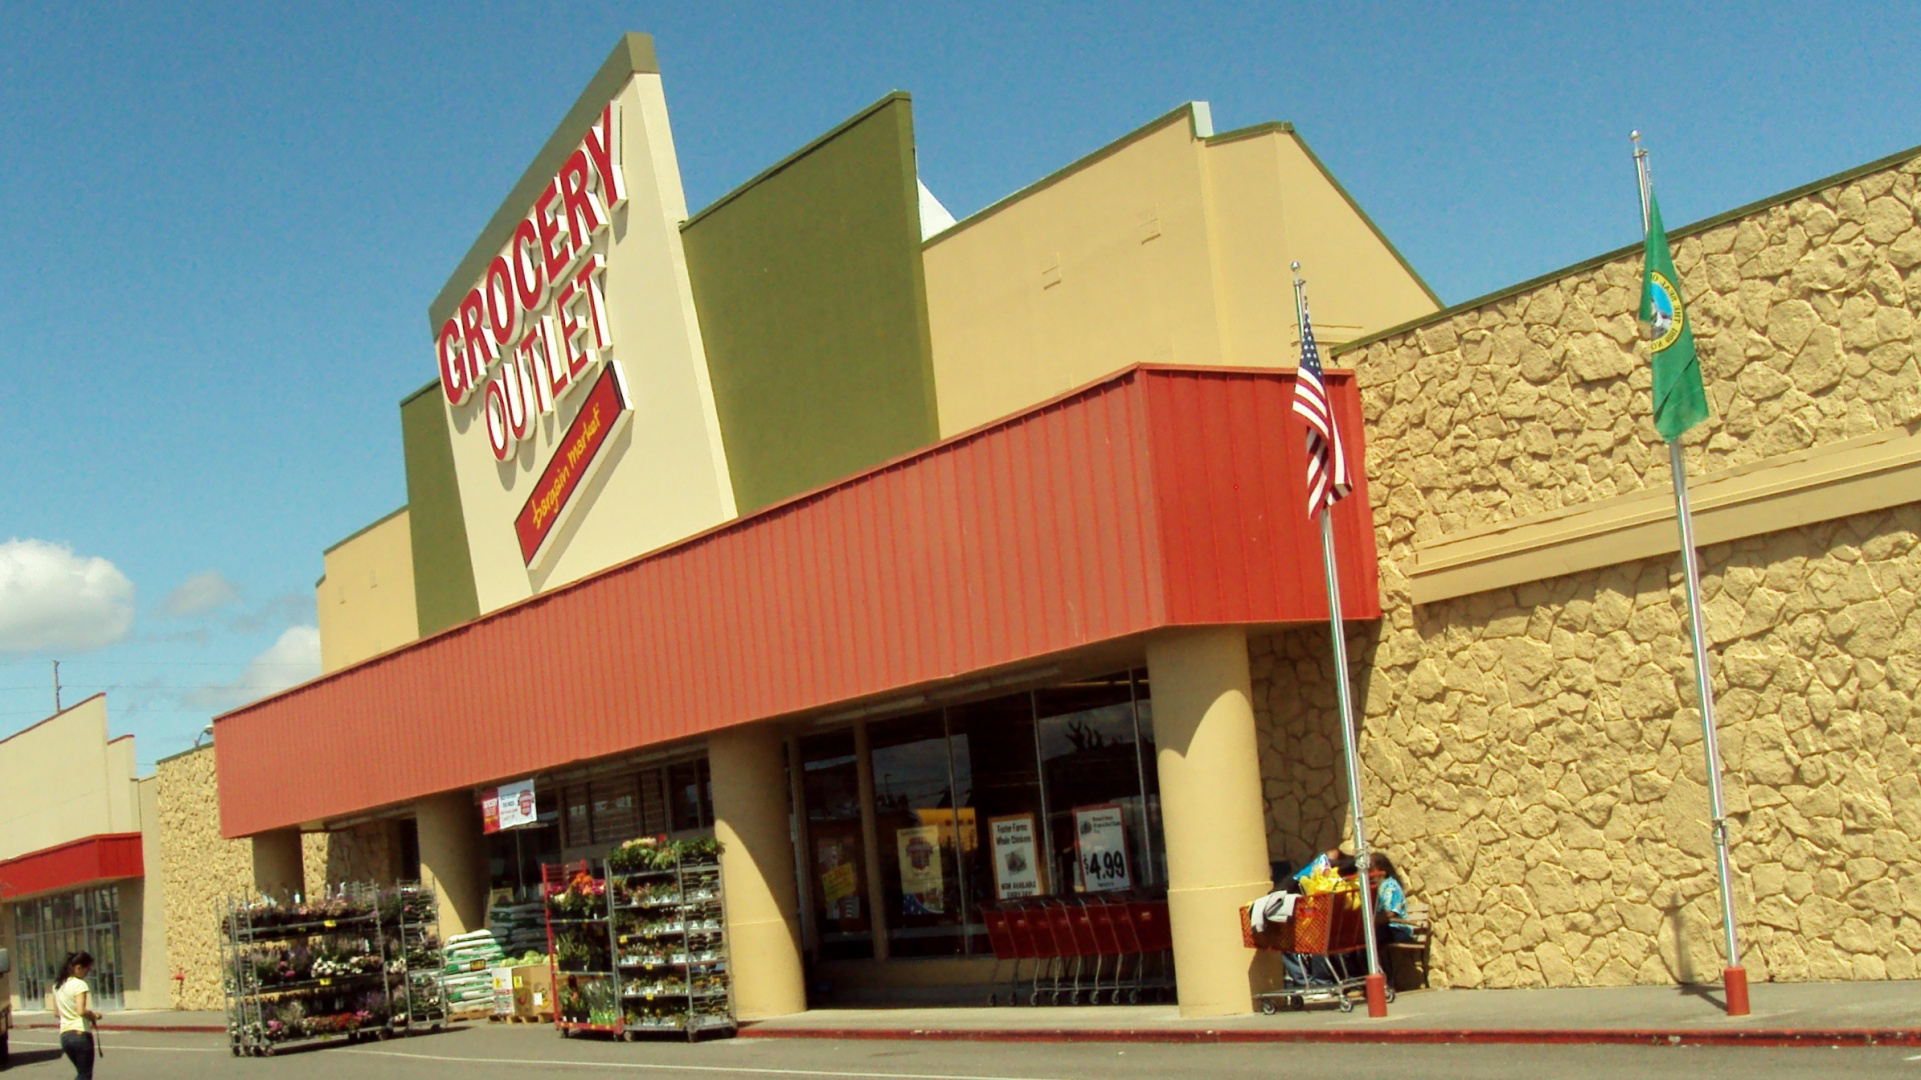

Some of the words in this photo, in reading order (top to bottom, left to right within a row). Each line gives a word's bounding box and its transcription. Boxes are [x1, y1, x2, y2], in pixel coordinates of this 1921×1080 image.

[439, 100, 627, 406] GROCERY
[485, 253, 613, 461] OUTLET
[532, 466, 570, 530] bargain
[567, 403, 600, 469] market
[996, 836, 1011, 846] Whole
[1013, 823, 1028, 832] Farms
[1083, 851, 1125, 880] $4.99
